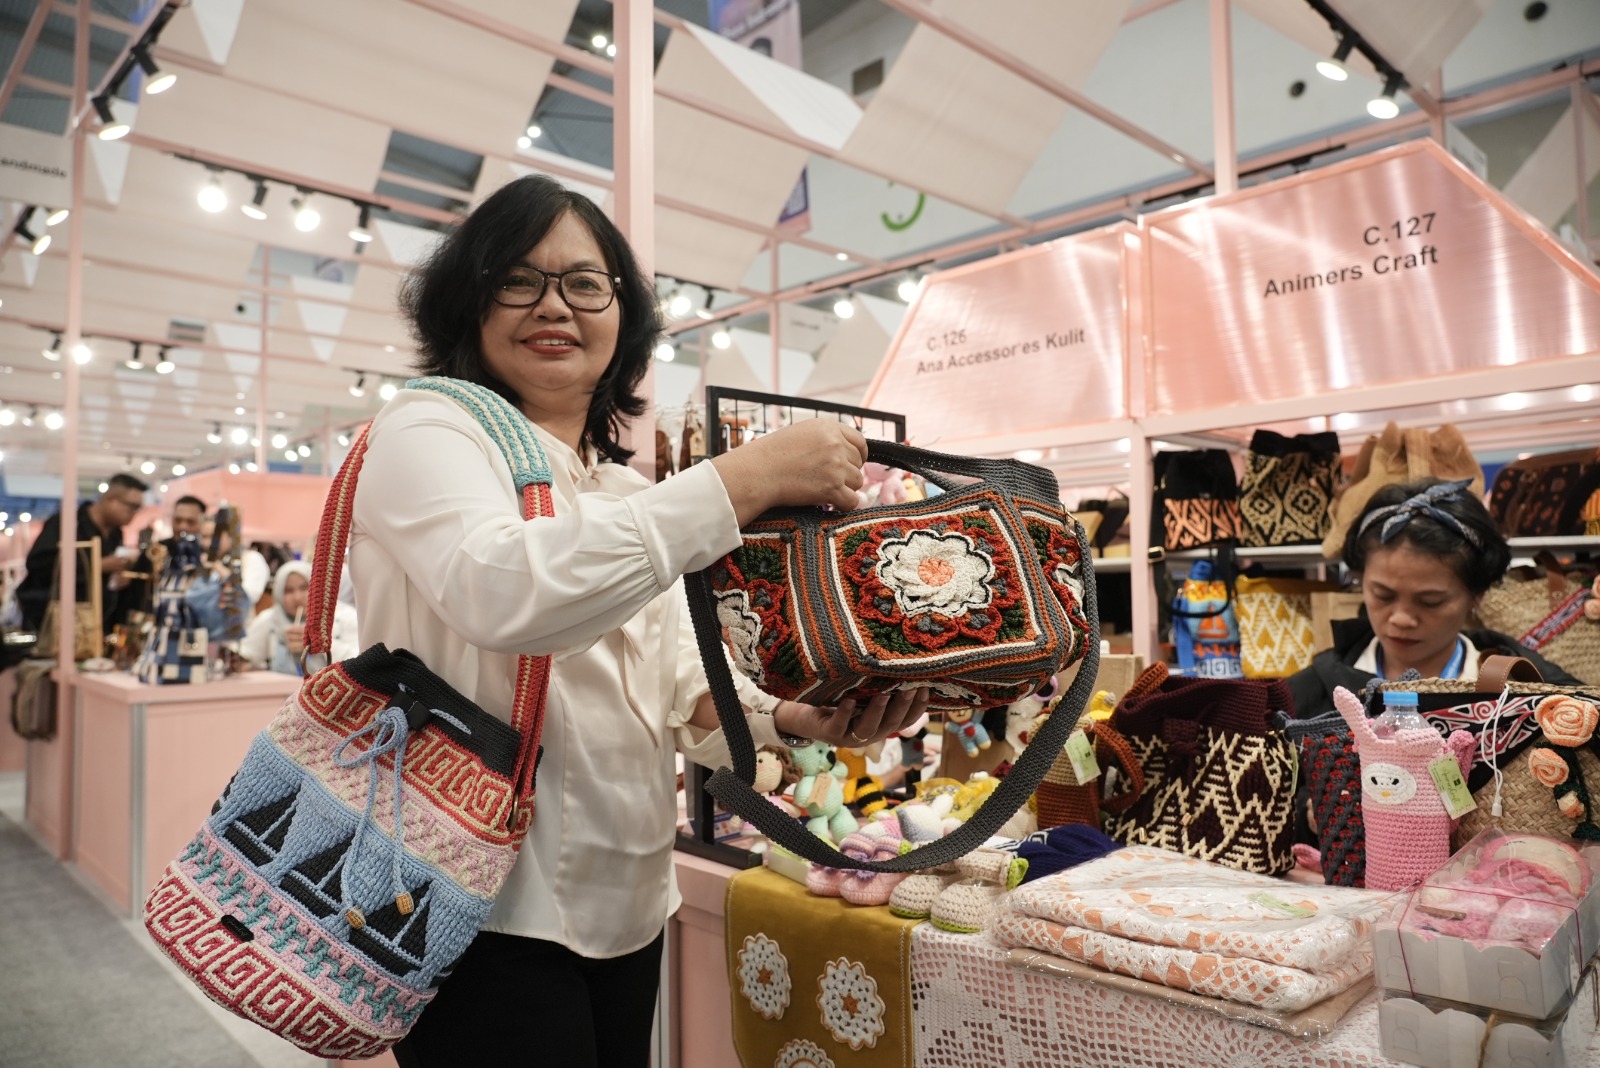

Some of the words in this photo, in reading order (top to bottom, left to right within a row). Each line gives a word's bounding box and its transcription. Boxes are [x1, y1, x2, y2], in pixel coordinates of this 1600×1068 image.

[1363, 212, 1436, 246] C.127
[1264, 265, 1363, 298] Animers
[1373, 245, 1439, 275] Craft
[917, 361, 943, 375] Ana
[948, 340, 1040, 370] Accessores
[1045, 328, 1085, 349] Kulit
[927, 329, 967, 351] C.126
